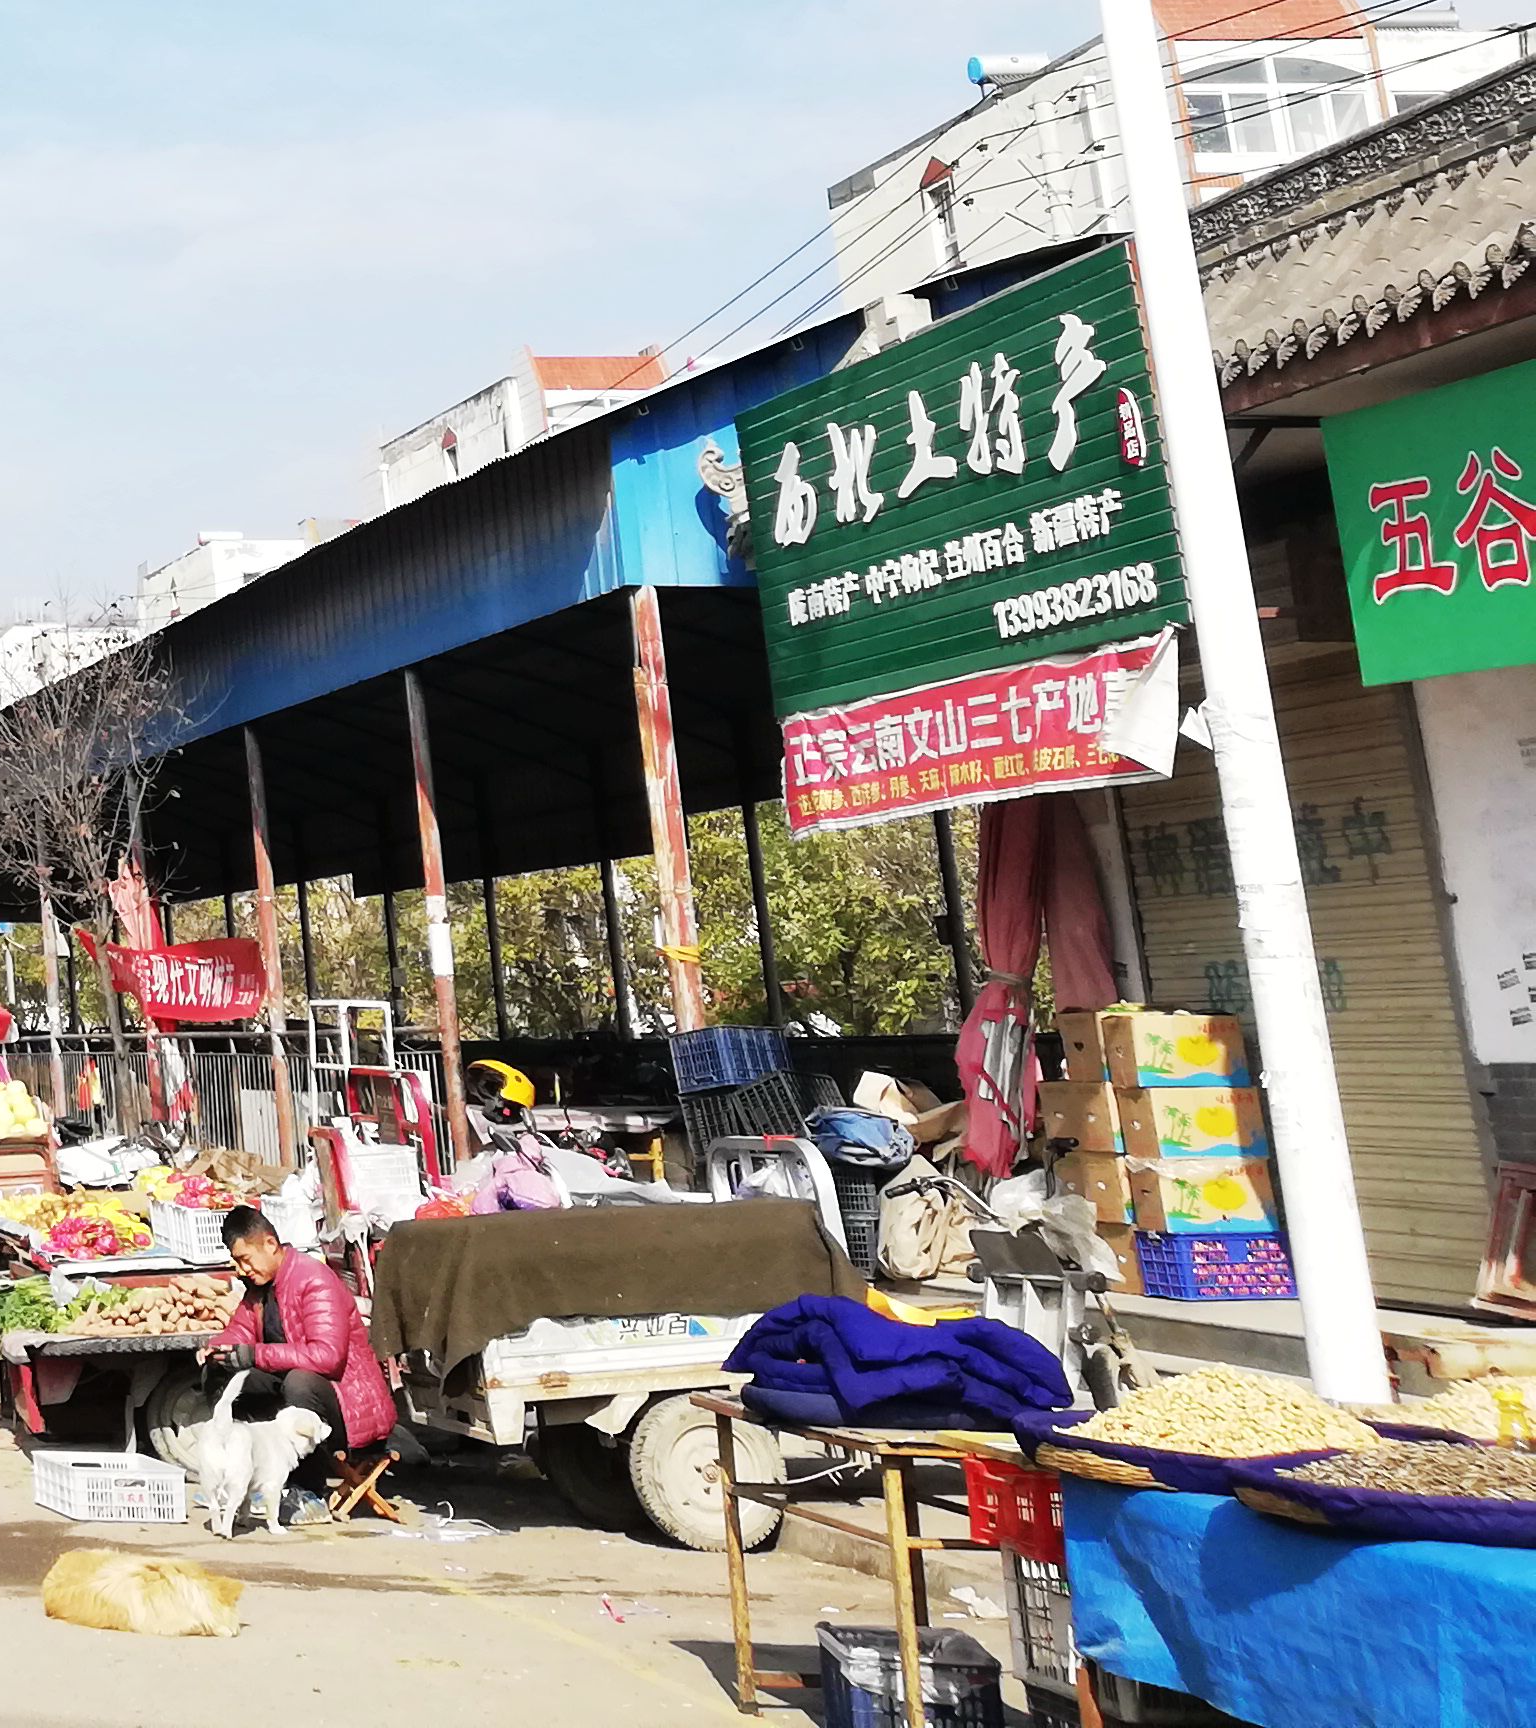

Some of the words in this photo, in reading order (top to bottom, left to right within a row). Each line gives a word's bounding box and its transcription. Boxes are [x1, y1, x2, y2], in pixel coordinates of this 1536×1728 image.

[774, 314, 1107, 547] 西北土特产
[788, 572, 860, 626] 陇南特产
[865, 549, 942, 604] 中宁枸杞
[944, 522, 1025, 580] 兰州百合
[1030, 488, 1123, 553] 新疆特产
[1368, 446, 1536, 605] 五谷
[993, 563, 1159, 640] 13993823168
